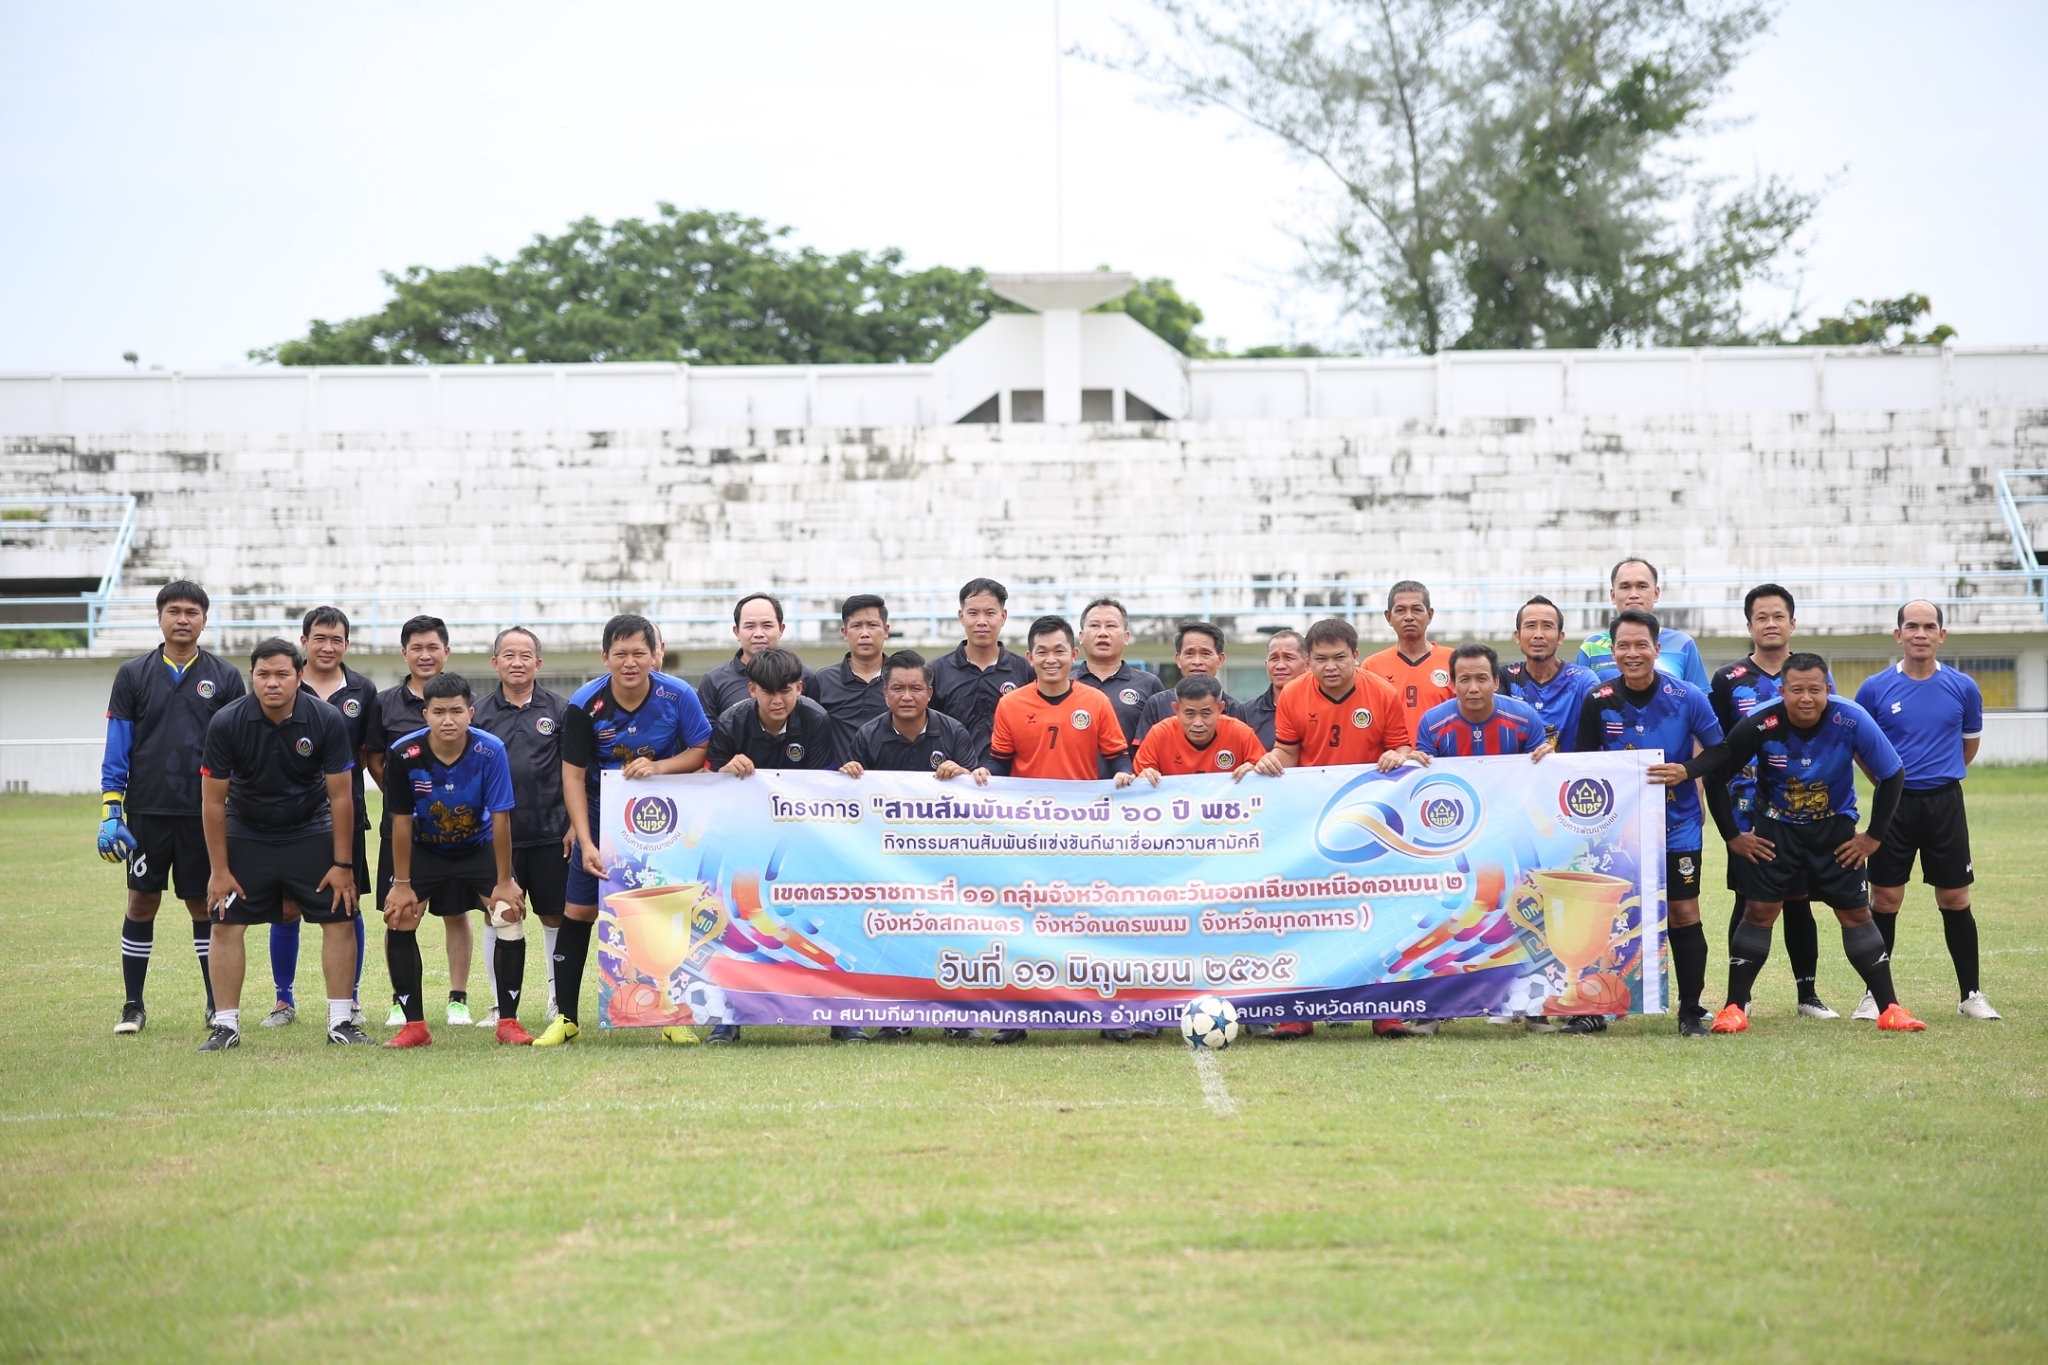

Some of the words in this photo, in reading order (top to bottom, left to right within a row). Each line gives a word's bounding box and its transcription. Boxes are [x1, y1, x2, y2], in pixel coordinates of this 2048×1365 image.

[1406, 686, 1417, 707] 9
[1048, 726, 1059, 749] 7
[1329, 725, 1341, 747] 3
[772, 796, 860, 818] โครงการ
[1122, 805, 1162, 821] ๖๐
[1172, 799, 1190, 820] ปี
[774, 879, 955, 902] เขตตรวจราชการที่
[963, 888, 995, 903] ๑๑
[1003, 876, 1438, 907] กลุ่มจังหวัดภาคตะวันออกเฉียงเหนือตอนบน
[1446, 875, 1463, 890] ๒
[867, 911, 1020, 934] (จังหวัดสกลนคร
[1035, 915, 1187, 933] จังหวัดนครพนม
[942, 945, 1001, 983] วันที่
[1015, 963, 1055, 983] ๑๑
[1069, 956, 1191, 991] มิถุนายน
[1205, 957, 1293, 983] ๒๕๖๕
[812, 1008, 831, 1021] ณ
[840, 1006, 1102, 1024] สนามกีฬาเทศบาลนครสกลนคร
[1294, 998, 1427, 1016] จังหวัดสกลนคร
